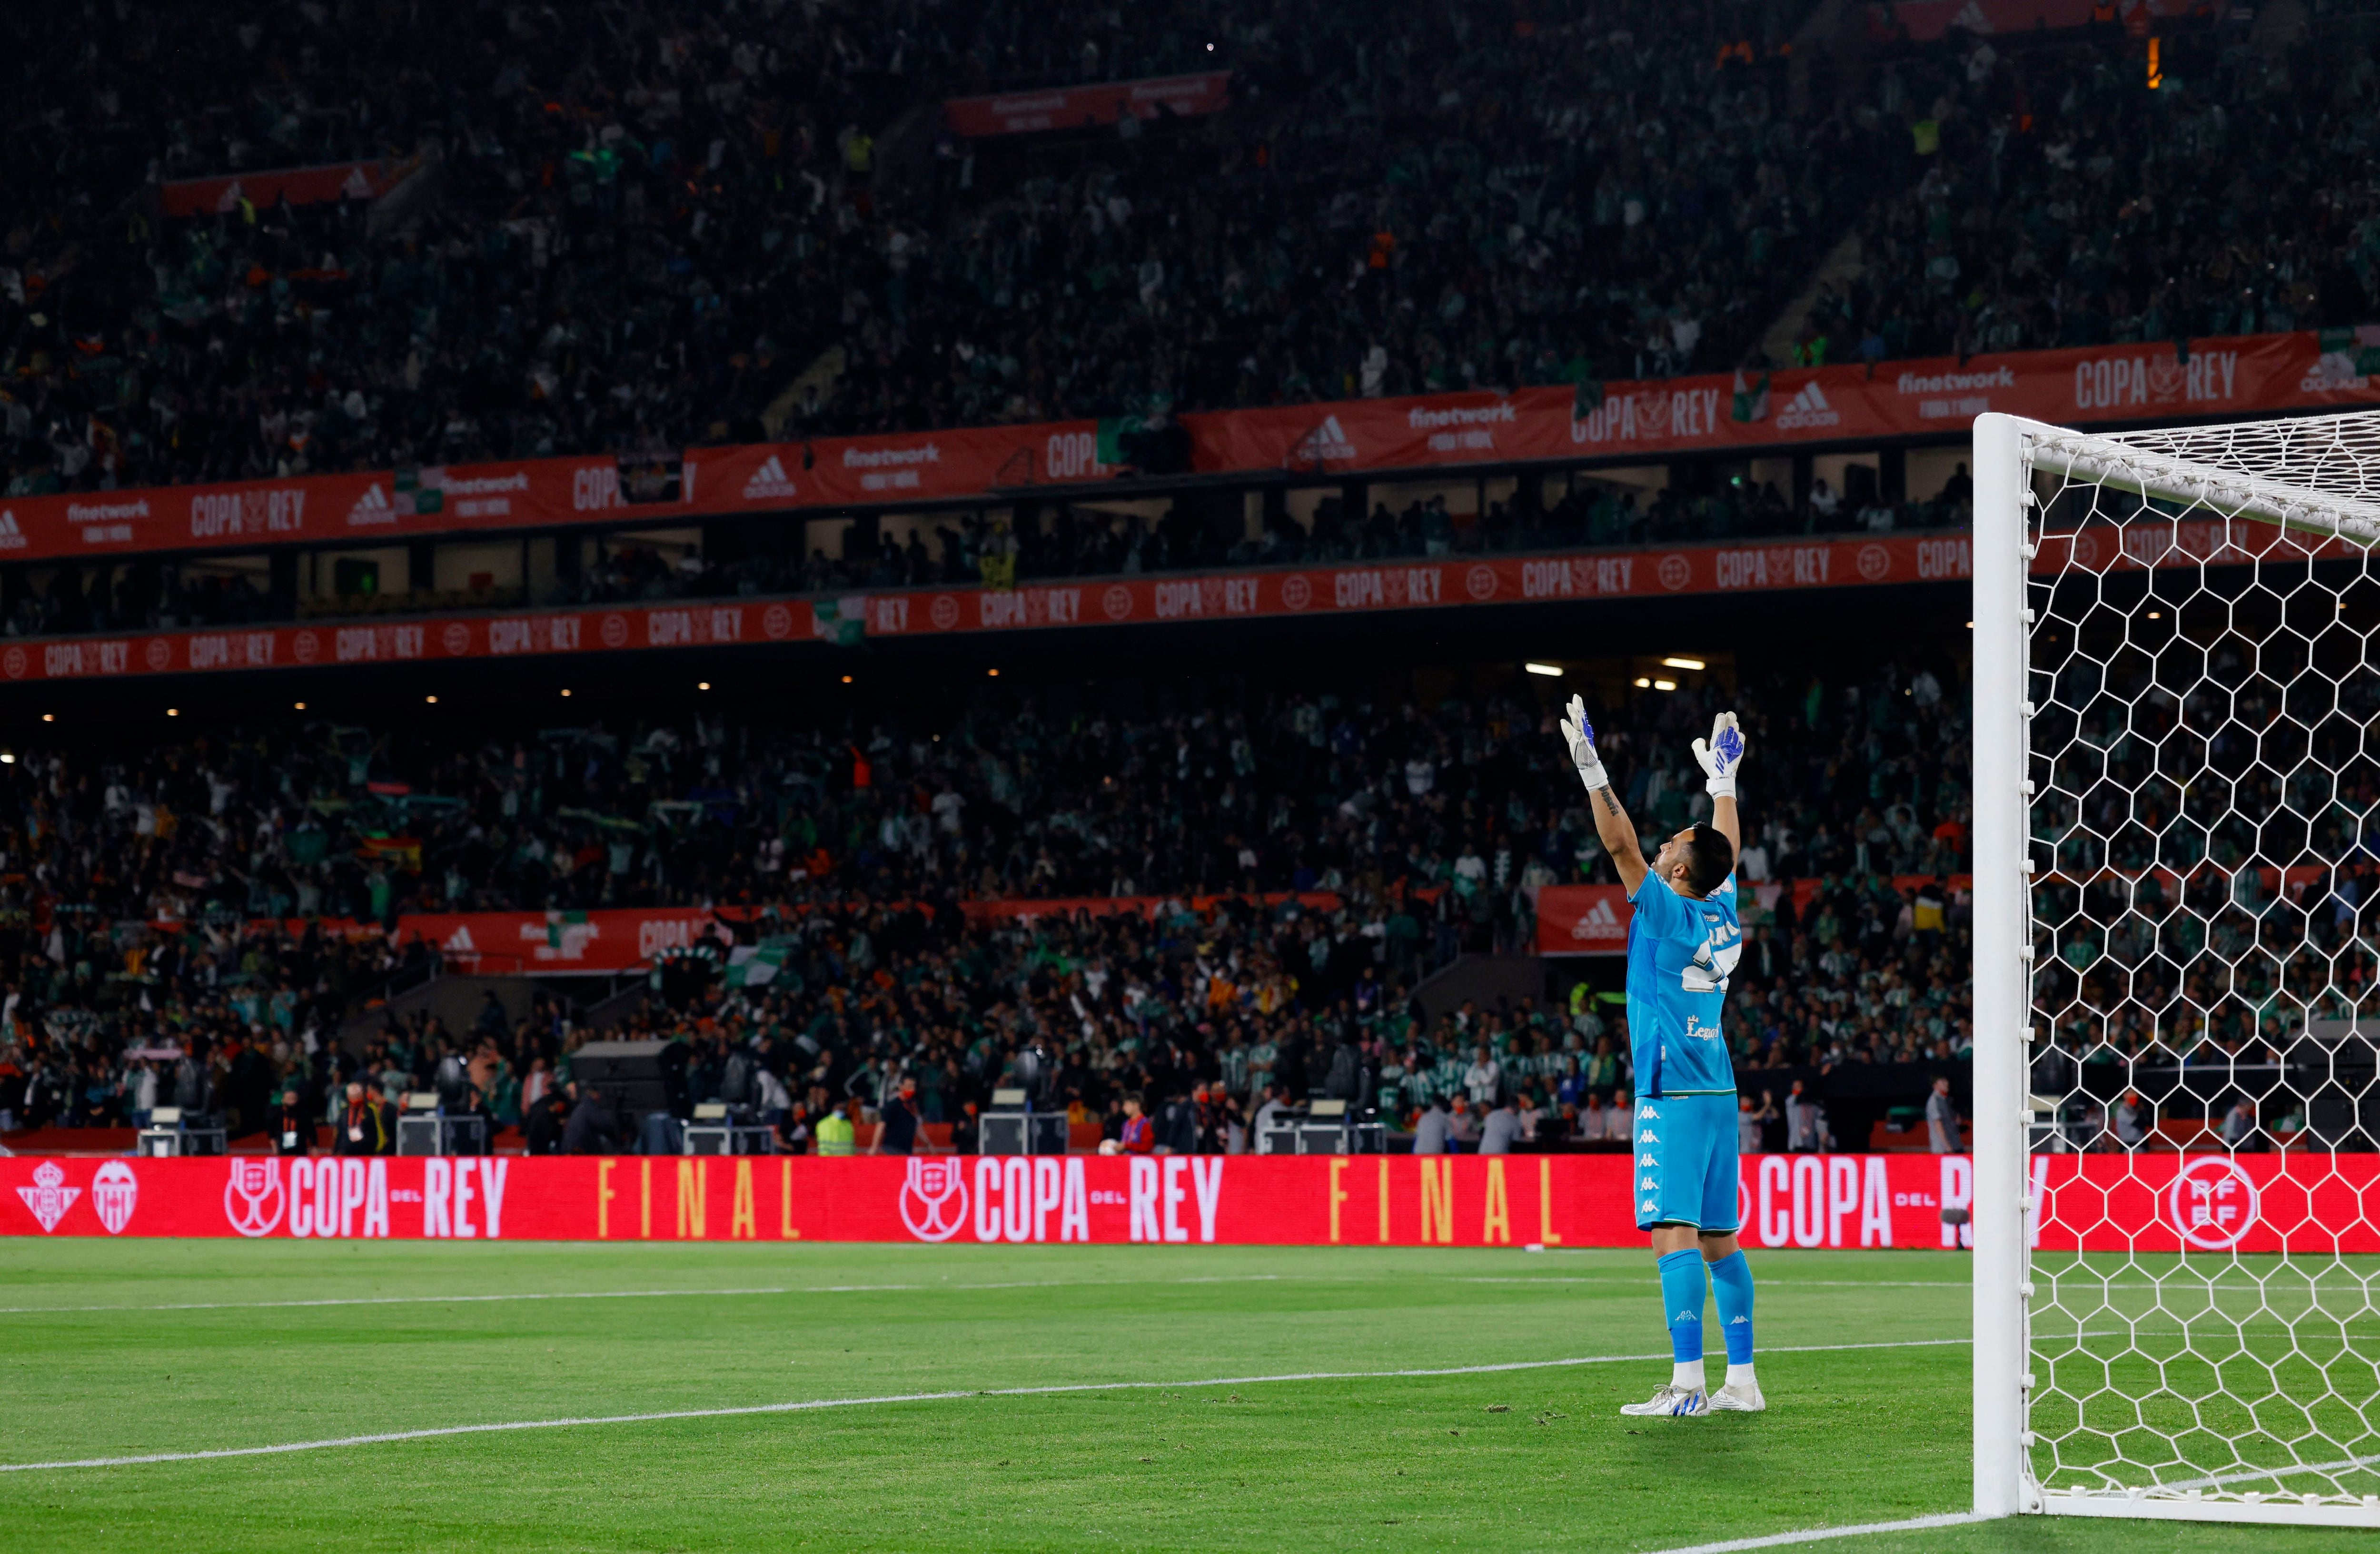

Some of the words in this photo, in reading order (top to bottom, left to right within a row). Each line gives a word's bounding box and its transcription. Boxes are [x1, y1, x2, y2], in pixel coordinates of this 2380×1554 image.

[1897, 365, 2014, 394] finetwork
[2076, 354, 2147, 409] COPA
[2187, 351, 2237, 401] REY
[1408, 402, 1516, 427] finetwork
[1671, 388, 1719, 436] REY
[843, 443, 939, 466] finetwork
[192, 493, 242, 538] COPA
[268, 490, 306, 531] REY
[1523, 559, 1571, 598] COPA
[1597, 557, 1633, 592] REY
[1716, 550, 1765, 587] COPA
[1794, 547, 1830, 583] REY
[1918, 540, 1970, 578] COPA
[1155, 581, 1201, 617] COPA
[1226, 579, 1259, 612] REY
[1335, 571, 1383, 607] COPA
[1408, 568, 1441, 602] REY
[981, 593, 1026, 626] COPA
[1050, 588, 1081, 622] REY
[336, 628, 374, 660] COPA
[395, 626, 425, 658] REY
[489, 619, 530, 653] COPA
[551, 617, 581, 649] REY
[649, 612, 691, 645] COPA
[712, 608, 743, 641] REY
[45, 643, 82, 676] COPA
[101, 641, 128, 671] REY
[191, 635, 226, 667] COPA
[247, 632, 275, 663] REY
[289, 1158, 389, 1237] COPA
[391, 1189, 422, 1203] DEL
[423, 1158, 508, 1237] REY
[598, 1159, 801, 1238] FINAL
[974, 1157, 1089, 1243] COPA
[1091, 1190, 1126, 1205] DEL
[1130, 1157, 1224, 1243] REY
[1329, 1158, 1562, 1243] FINAL
[1759, 1156, 1893, 1247] COPA
[1895, 1192, 1936, 1207] DEL
